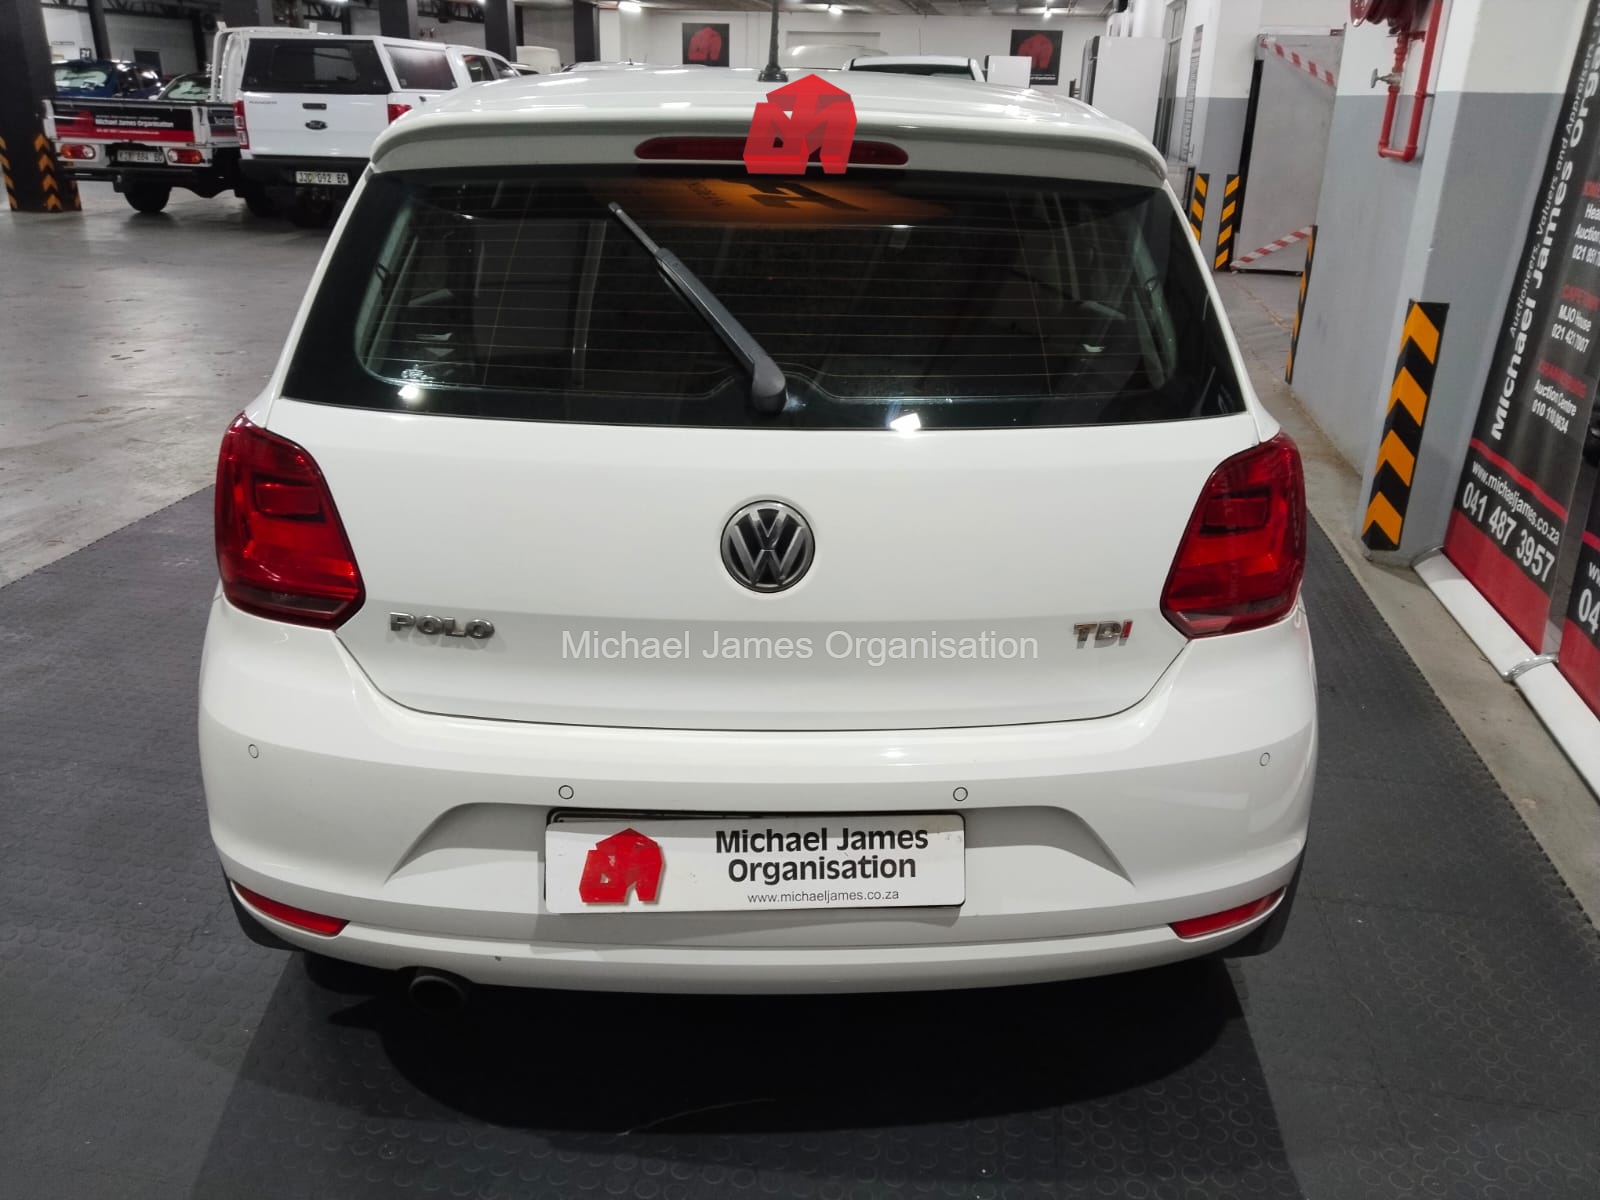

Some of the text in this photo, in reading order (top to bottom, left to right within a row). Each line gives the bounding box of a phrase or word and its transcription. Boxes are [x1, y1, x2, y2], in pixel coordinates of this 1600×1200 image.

[1536, 175, 1559, 235] Valuers
[1556, 137, 1568, 171] and
[1490, 296, 1537, 440] Michael
[1532, 160, 1573, 289] James
[1534, 379, 1559, 402] Auction
[1472, 460, 1560, 546] www.michaeljames.co.za
[1462, 482, 1555, 583] 041 487 3957
[389, 611, 496, 640] POLO
[1074, 620, 1133, 648] TDI
[716, 827, 929, 853] Michael James
[728, 855, 916, 885] Organisation
[747, 889, 900, 905] www.michaeljames.co.za
